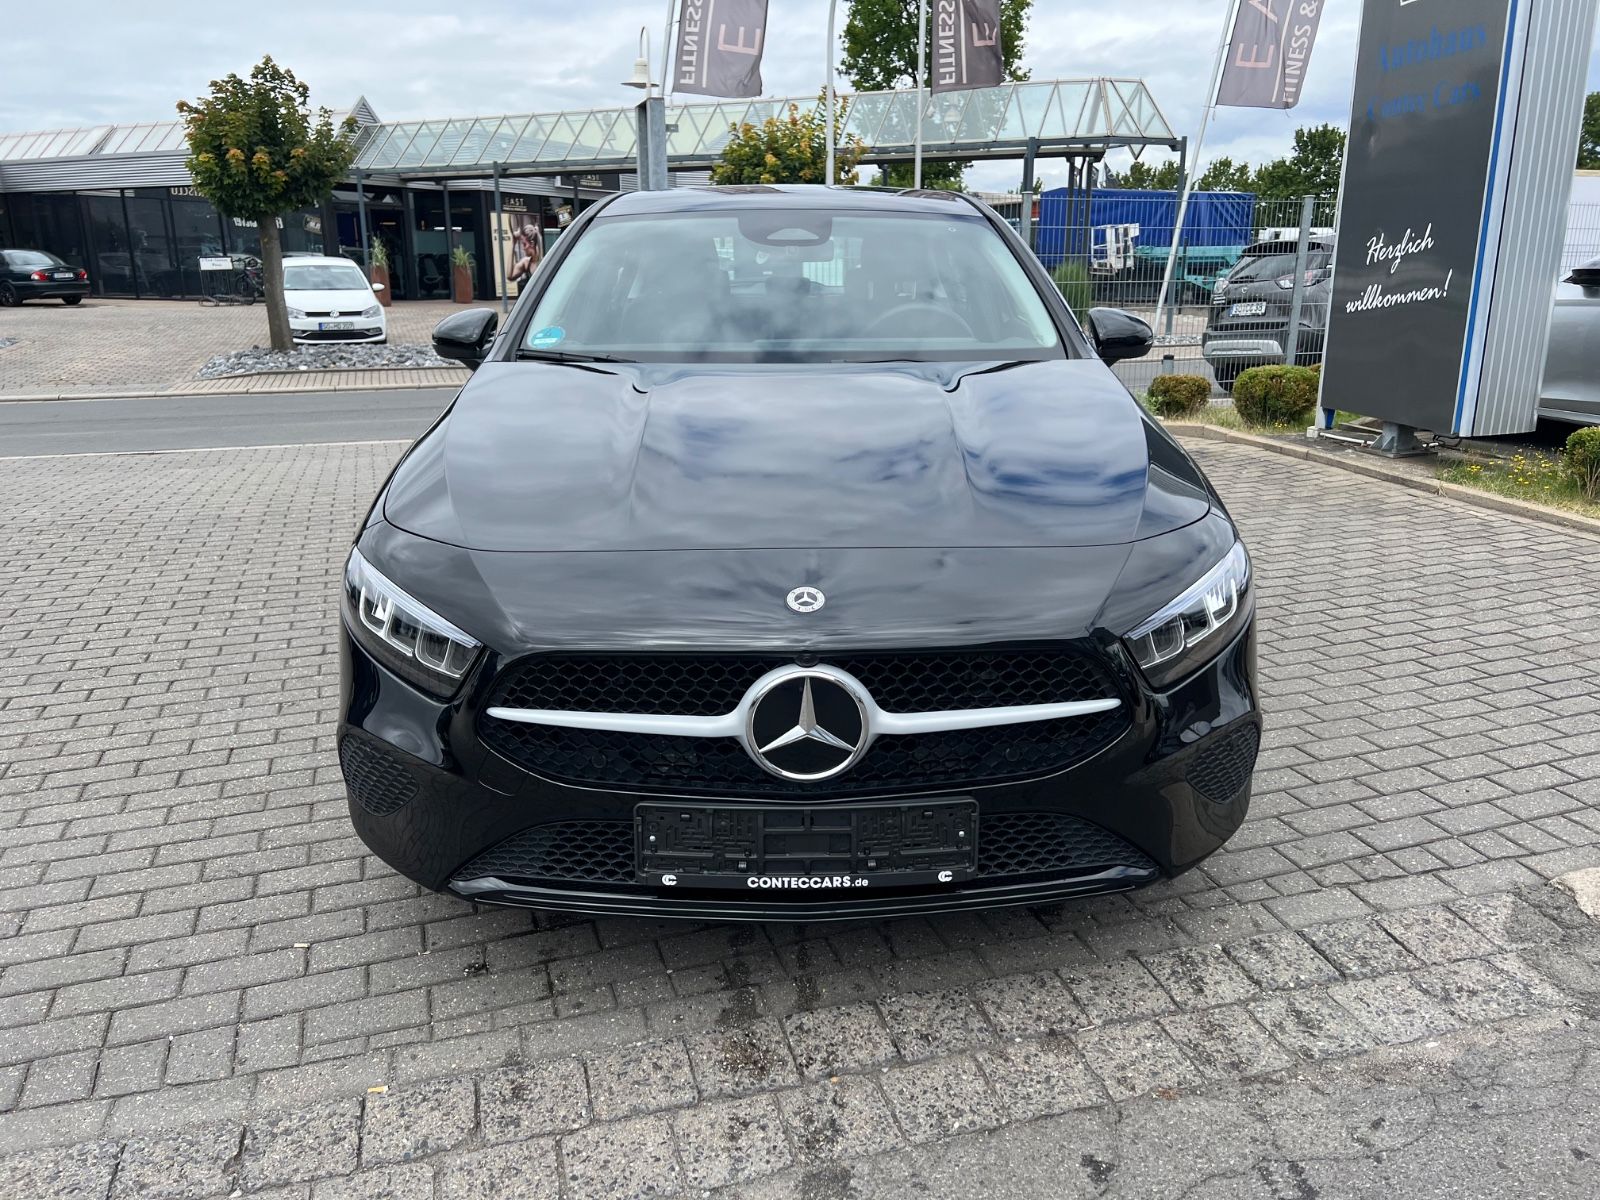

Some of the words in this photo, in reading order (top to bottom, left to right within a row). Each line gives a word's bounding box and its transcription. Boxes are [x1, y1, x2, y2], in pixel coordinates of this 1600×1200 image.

[1366, 222, 1435, 274] Herzlich
[1345, 268, 1453, 314] willkommen!
[746, 875, 869, 888] CONTECCARS.de
